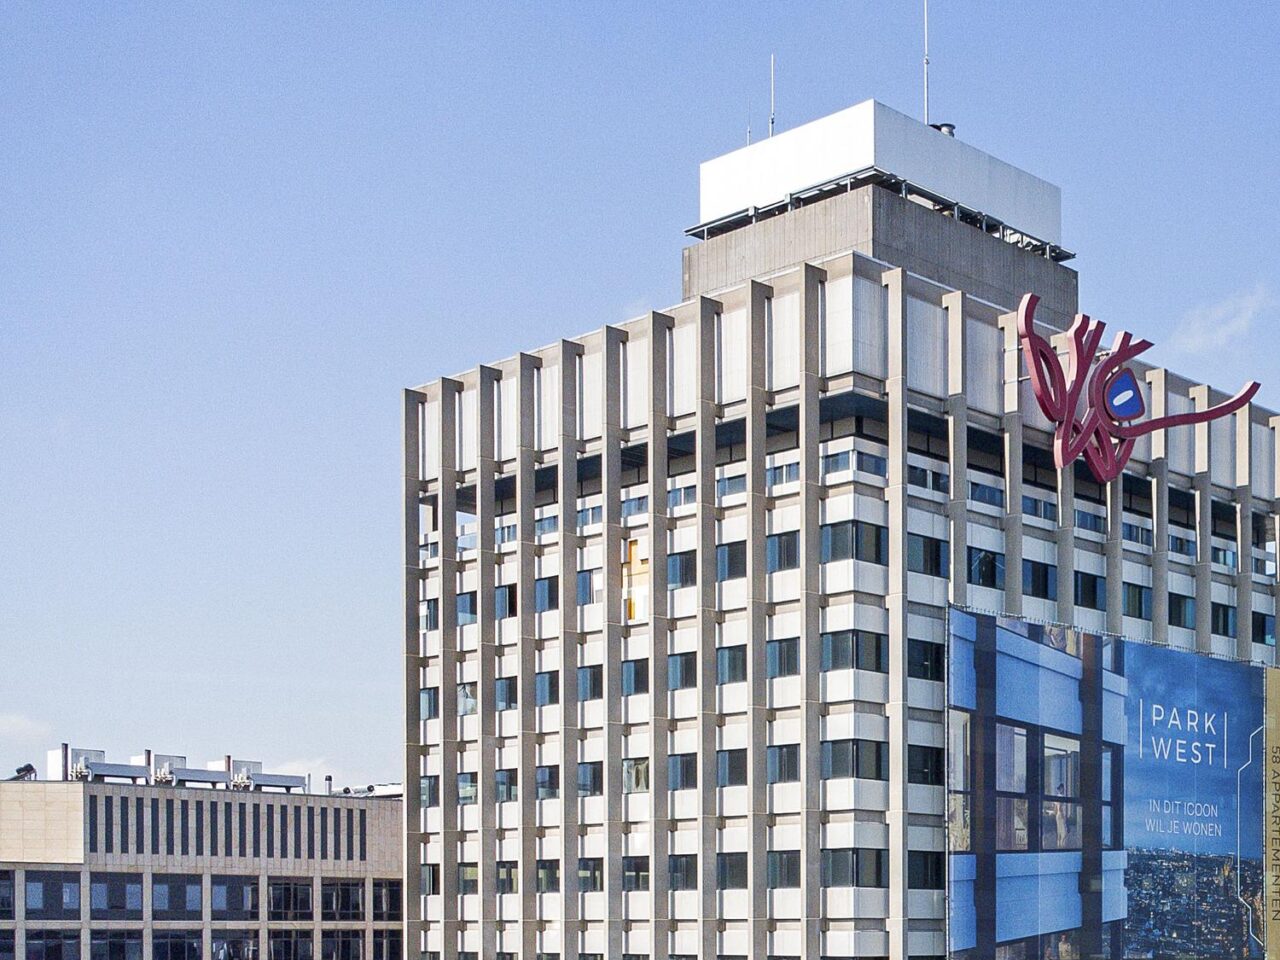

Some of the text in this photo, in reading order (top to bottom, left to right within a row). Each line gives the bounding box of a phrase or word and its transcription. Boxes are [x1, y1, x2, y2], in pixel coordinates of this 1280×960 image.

[1151, 703, 1217, 736] PARK
[1151, 736, 1217, 766] WEST
[1148, 799, 1218, 817] IN DIT ICOON
[1145, 819, 1222, 837] WIL JE WONEN
[1271, 745, 1280, 922] 58 APPARTEMENTEN
